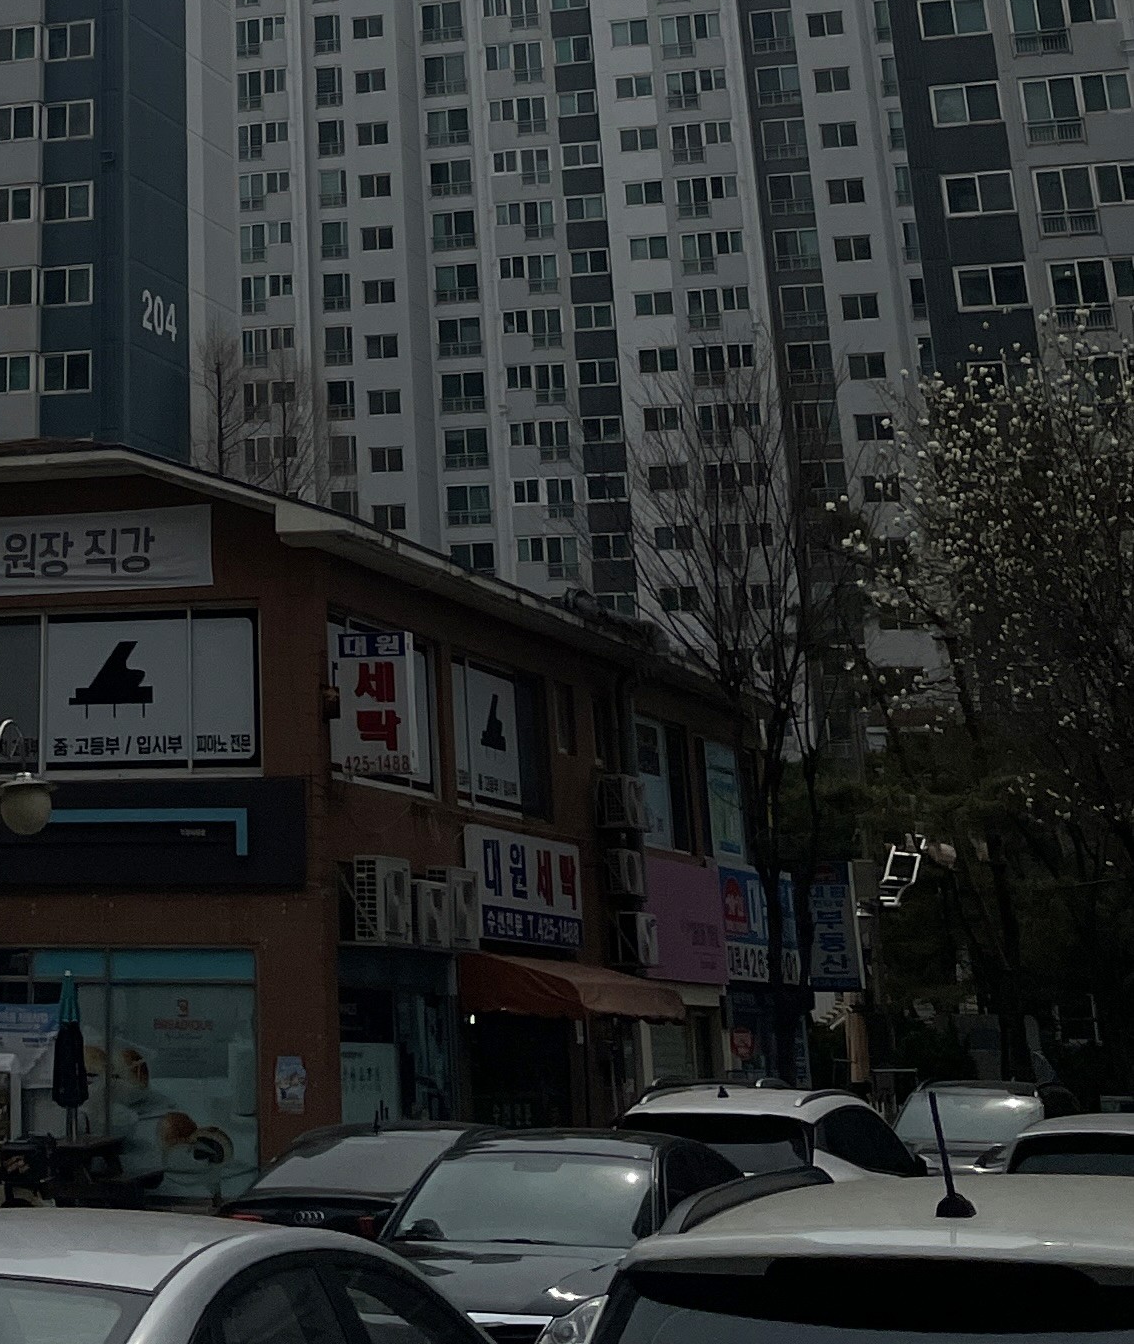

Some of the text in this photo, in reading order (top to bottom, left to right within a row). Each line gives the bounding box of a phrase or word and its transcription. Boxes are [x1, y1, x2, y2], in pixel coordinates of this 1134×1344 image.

[142, 288, 178, 343] 204
[2, 531, 73, 579] 원장
[84, 527, 156, 574] 직강
[342, 634, 400, 656] 대원
[354, 661, 402, 752] 세탁
[137, 735, 183, 755] 입시부
[196, 734, 227, 753] 피아노
[230, 734, 251, 753] 전문
[344, 754, 410, 773] 425-1488
[482, 838, 577, 911] 대원 세탁
[814, 910, 851, 976] 부동산
